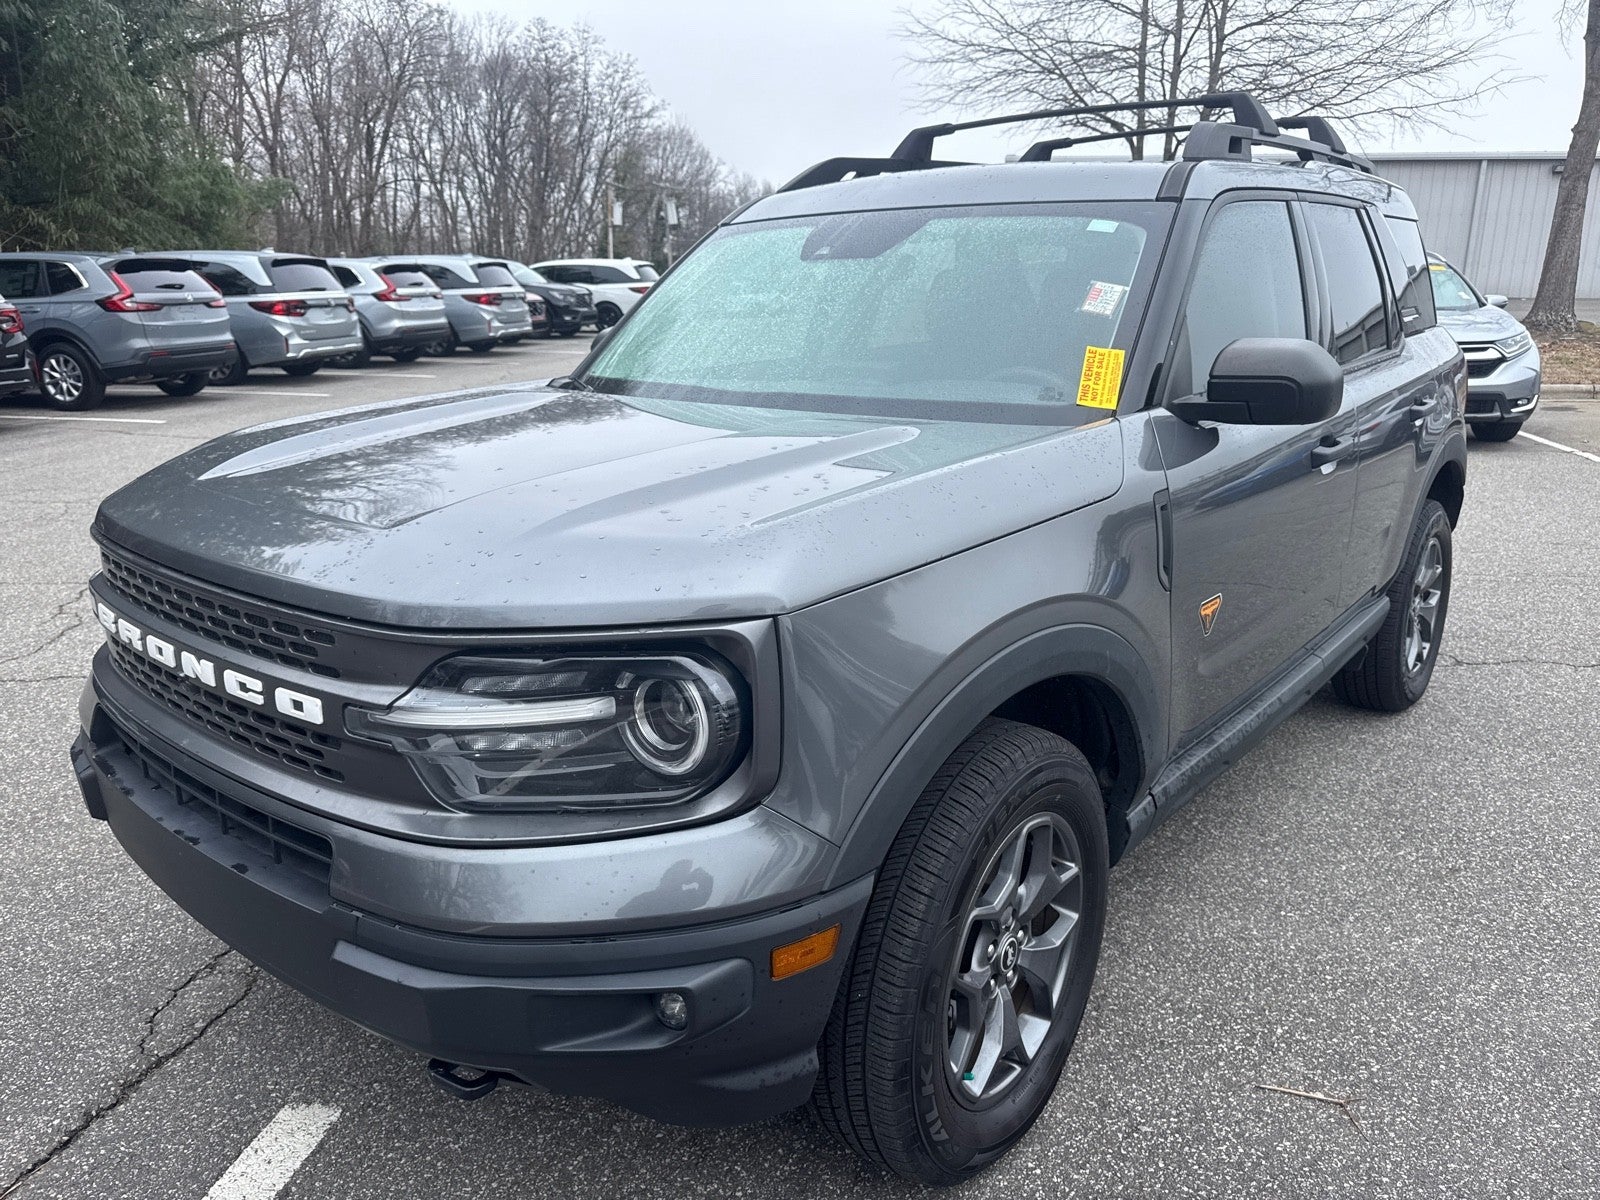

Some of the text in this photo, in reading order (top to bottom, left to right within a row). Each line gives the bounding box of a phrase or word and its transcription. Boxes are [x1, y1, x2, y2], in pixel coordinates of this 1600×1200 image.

[1096, 351, 1105, 370] SALE
[1079, 348, 1097, 402] THIS VEHICLE
[1093, 371, 1102, 386] FOR
[1090, 386, 1099, 402] NOT
[97, 602, 324, 725] BRONCO
